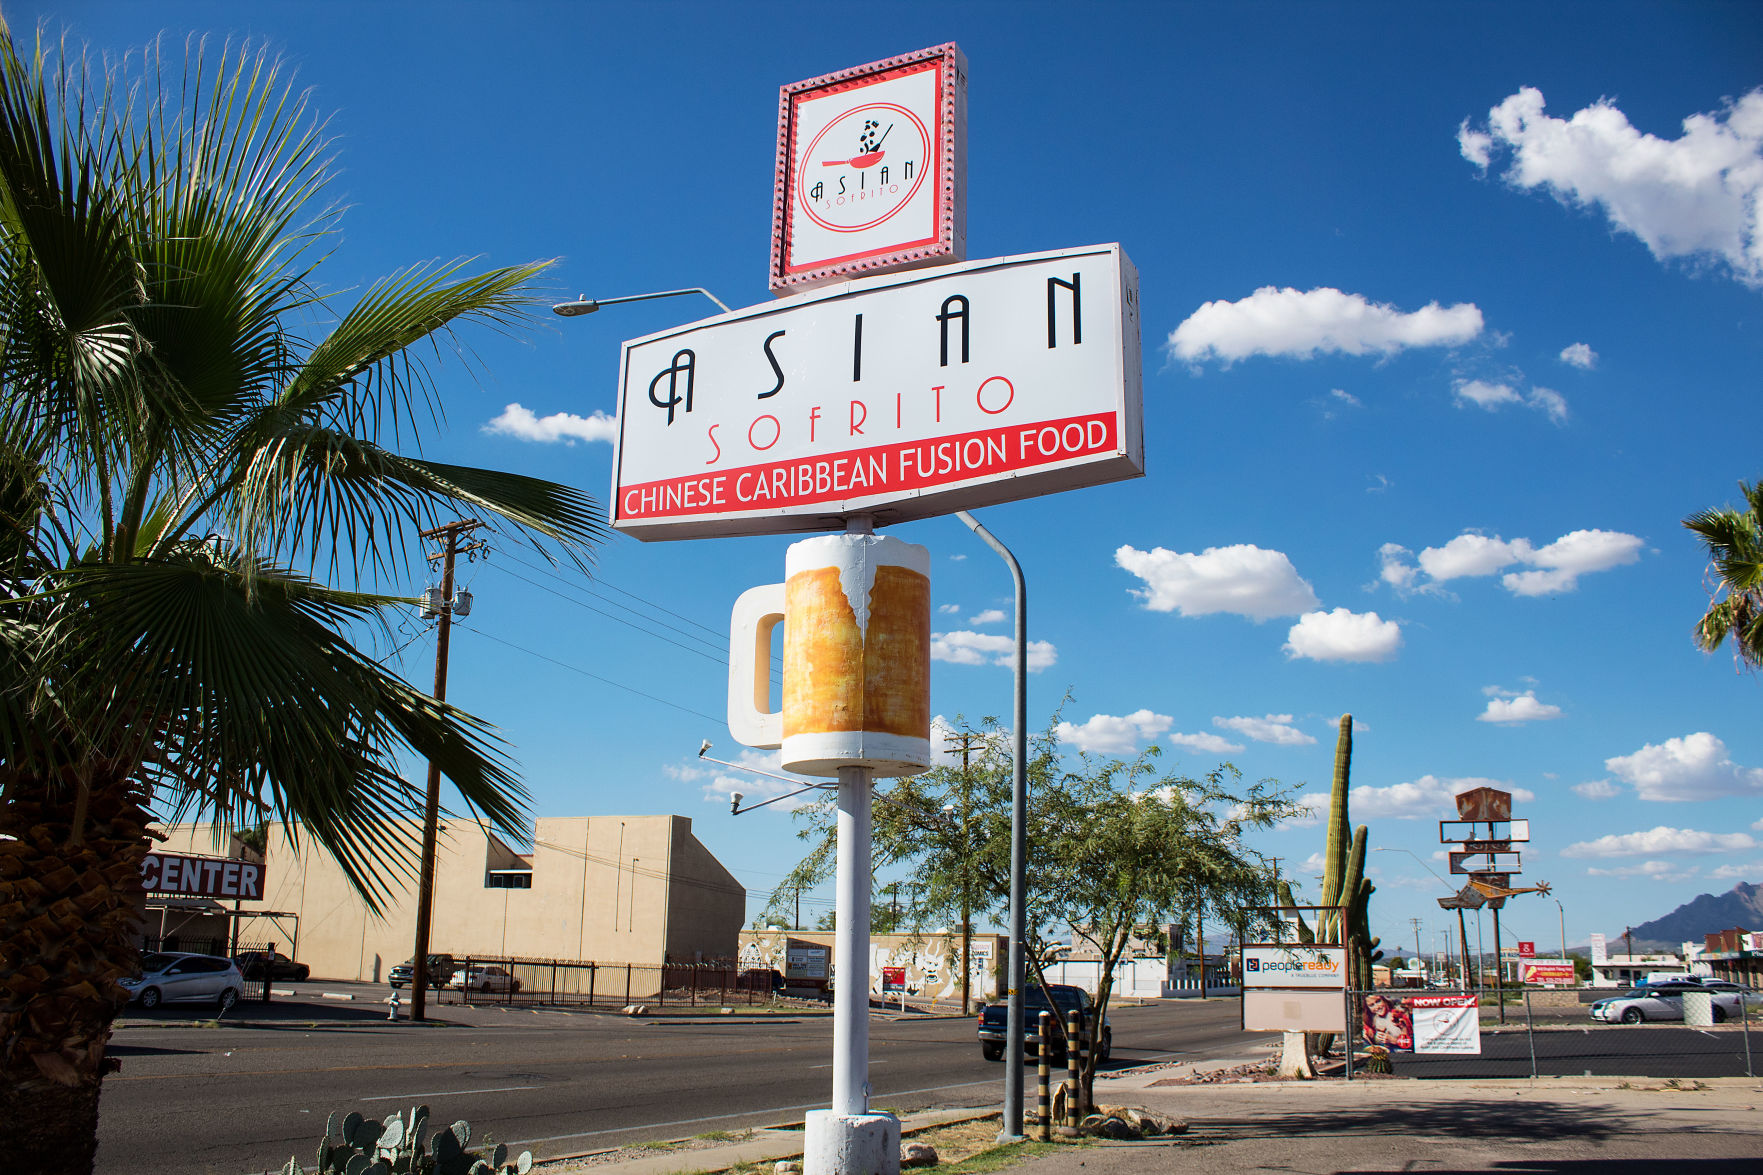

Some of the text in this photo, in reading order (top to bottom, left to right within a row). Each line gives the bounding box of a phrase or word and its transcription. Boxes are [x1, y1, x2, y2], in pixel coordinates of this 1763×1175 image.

[810, 160, 914, 203] ASIAN
[825, 184, 899, 210] SOFRITO
[648, 272, 1082, 427] ASIAN
[706, 375, 1015, 465] SOFRITO
[624, 420, 1108, 516] CHINESE CARIBBEAN FUSION FOOD
[139, 855, 259, 897] CENTER
[1262, 959, 1340, 974] peopleready
[1413, 998, 1441, 1006] NOW
